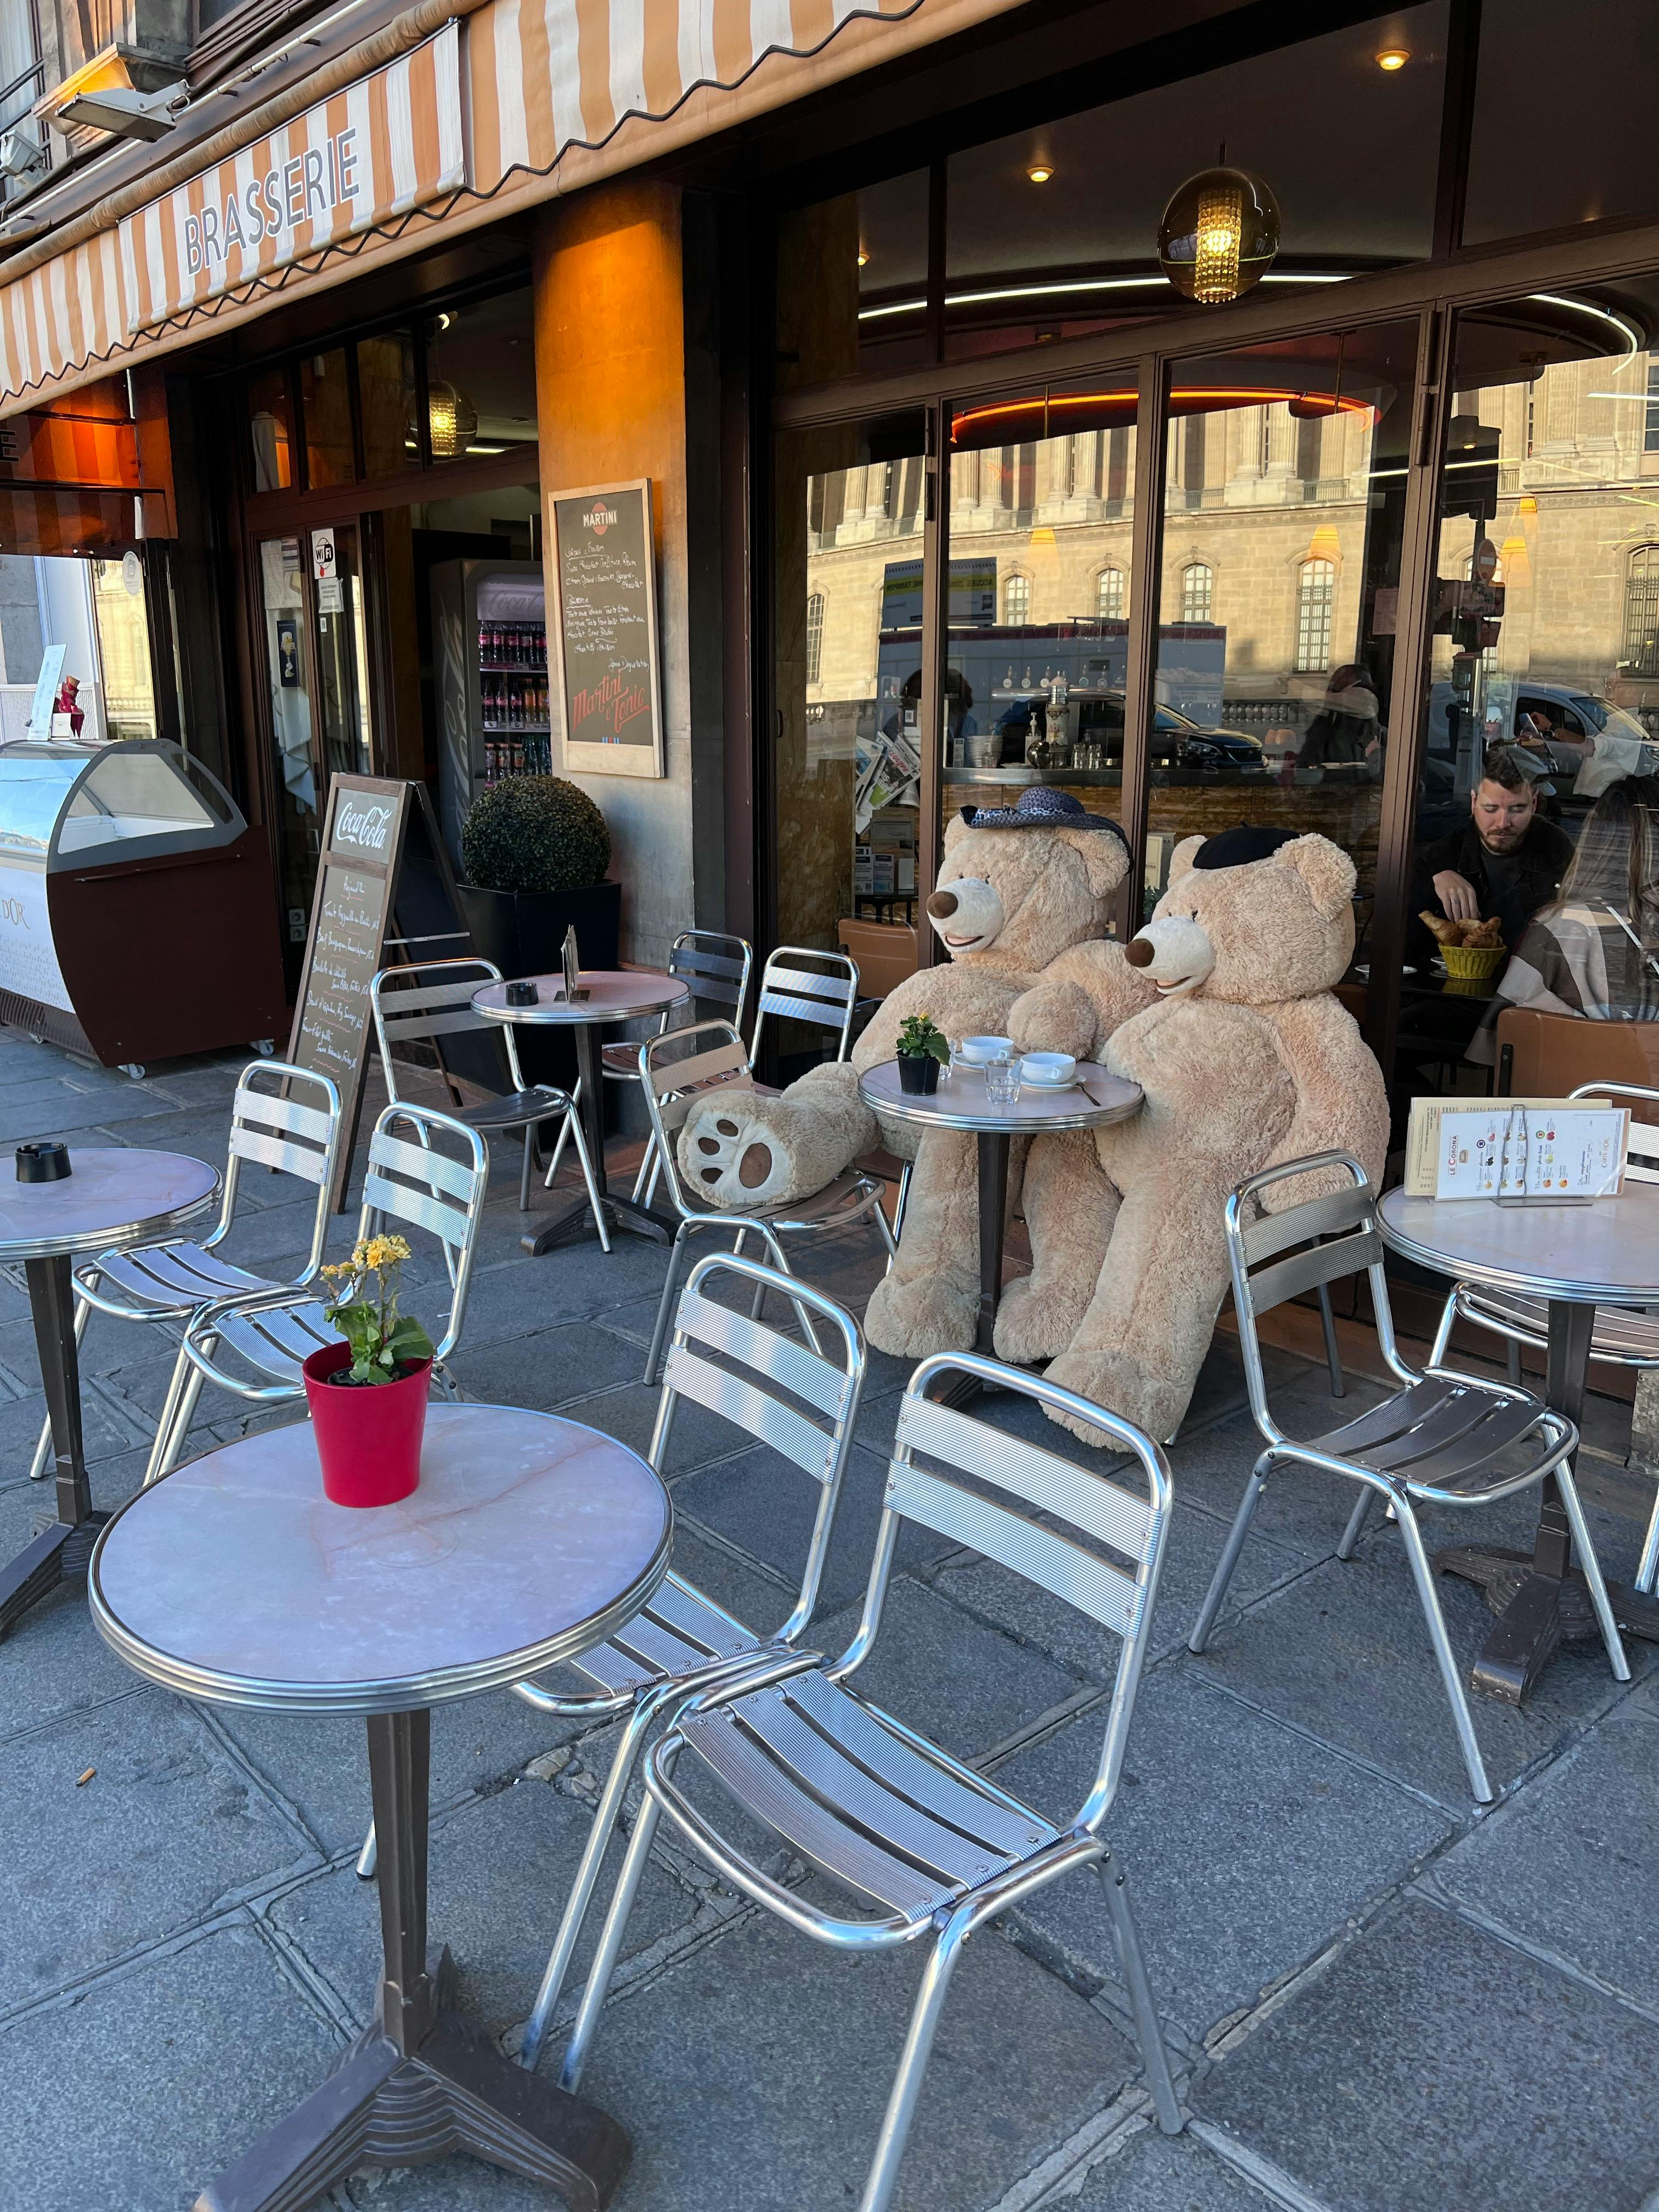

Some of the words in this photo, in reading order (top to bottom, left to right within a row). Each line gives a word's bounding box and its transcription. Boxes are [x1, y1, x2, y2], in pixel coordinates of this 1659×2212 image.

[185, 126, 359, 275] BRASSERIE
[583, 511, 617, 527] MARTINI
[573, 669, 622, 732] Martini
[612, 684, 650, 733] Tonic
[337, 802, 393, 849] Coca-Cola
[1448, 1135, 1458, 1165] CORONA
